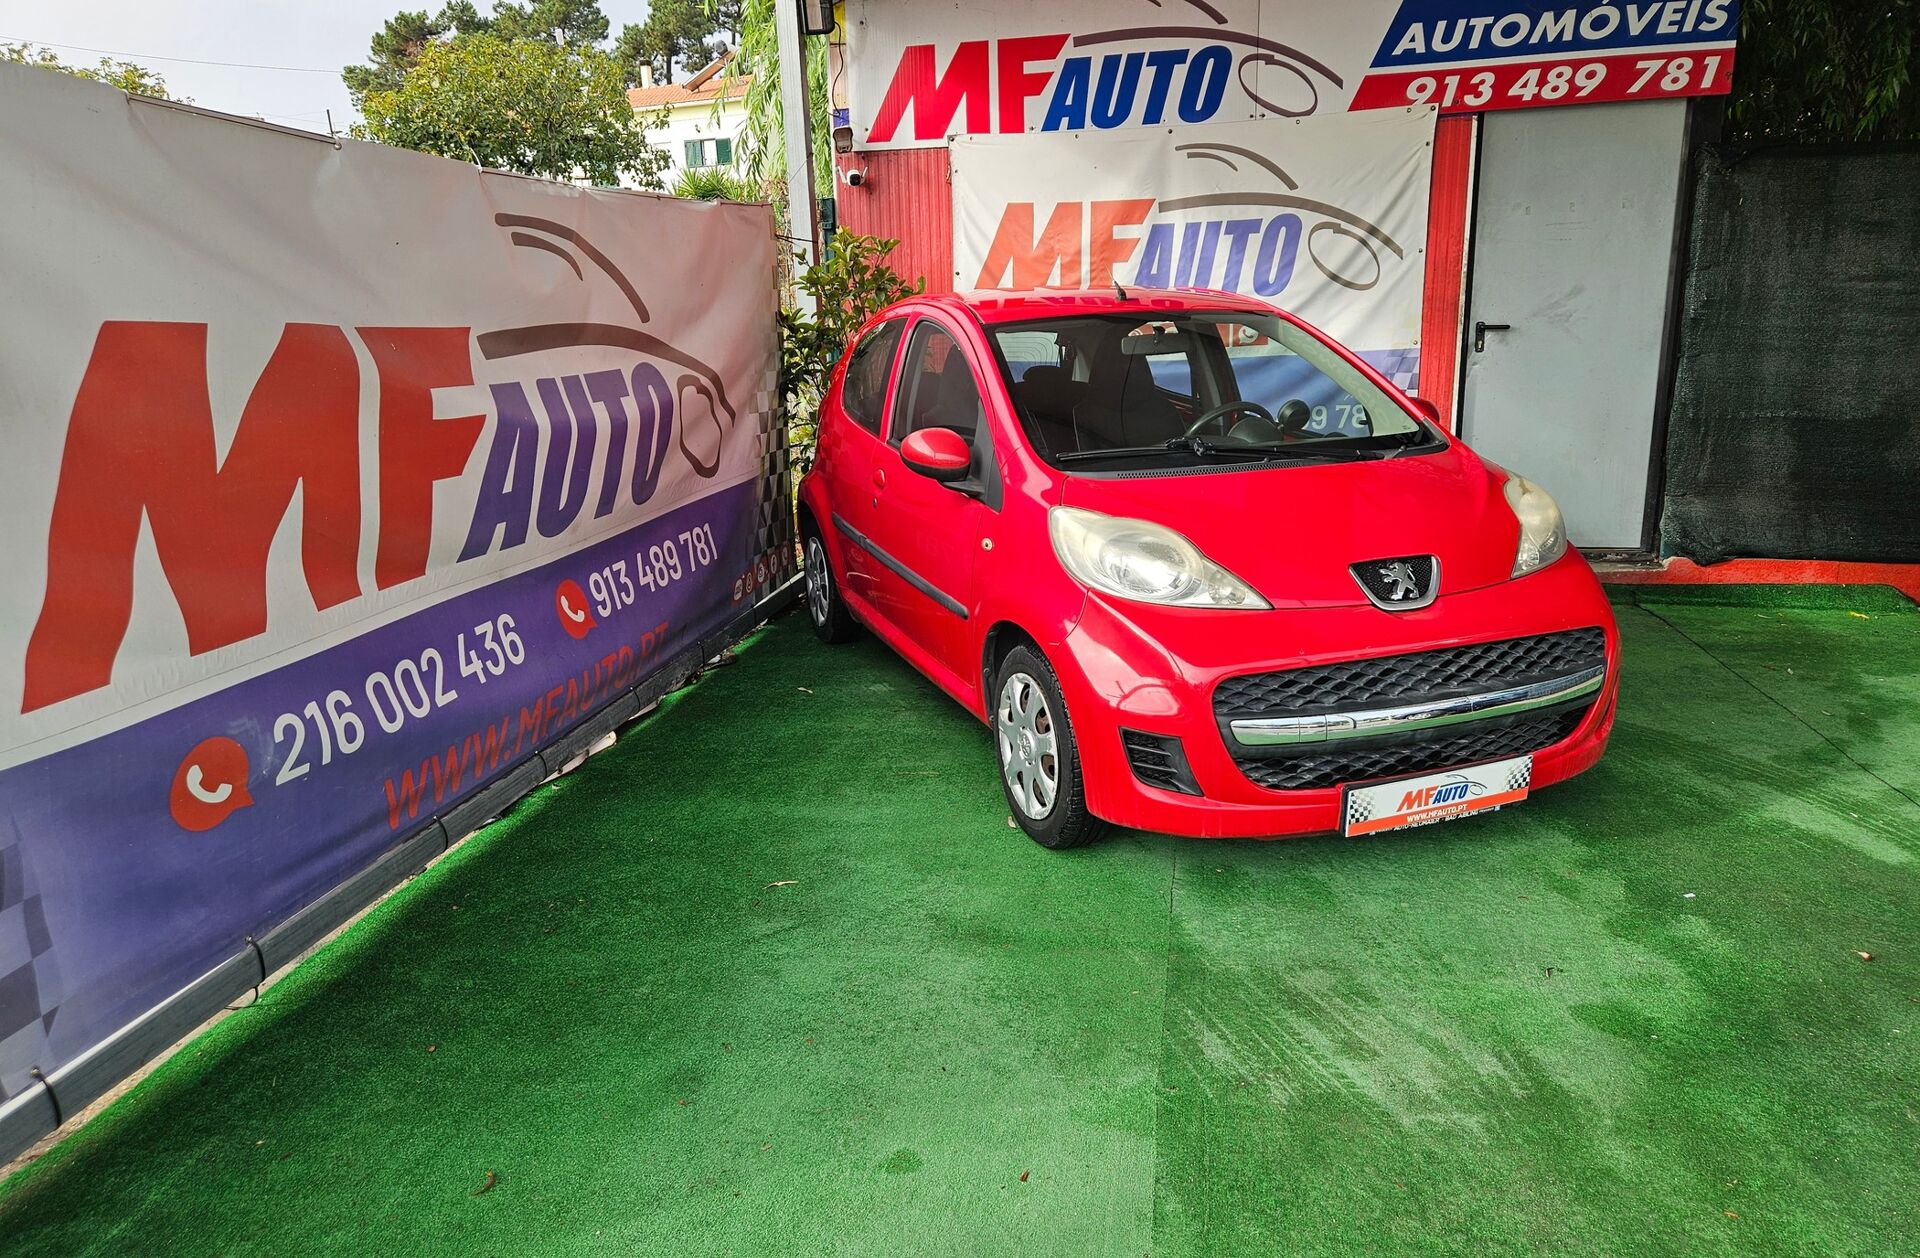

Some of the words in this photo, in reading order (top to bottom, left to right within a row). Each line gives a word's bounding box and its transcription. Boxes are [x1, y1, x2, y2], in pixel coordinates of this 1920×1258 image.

[1391, 0, 1731, 56] AUTOMÓVEIS
[1405, 71, 1496, 108] 913
[1508, 63, 1608, 101] 489
[1626, 56, 1722, 94] 781
[589, 560, 635, 618] 913
[637, 539, 682, 592] 489
[678, 523, 718, 572] 781
[273, 690, 366, 787] 216
[373, 647, 459, 733] 002
[457, 613, 526, 684] 436
[384, 622, 669, 831] WWW.MFAUTO.PT
[1406, 804, 1468, 823] WWW.MFAUTO.PT
